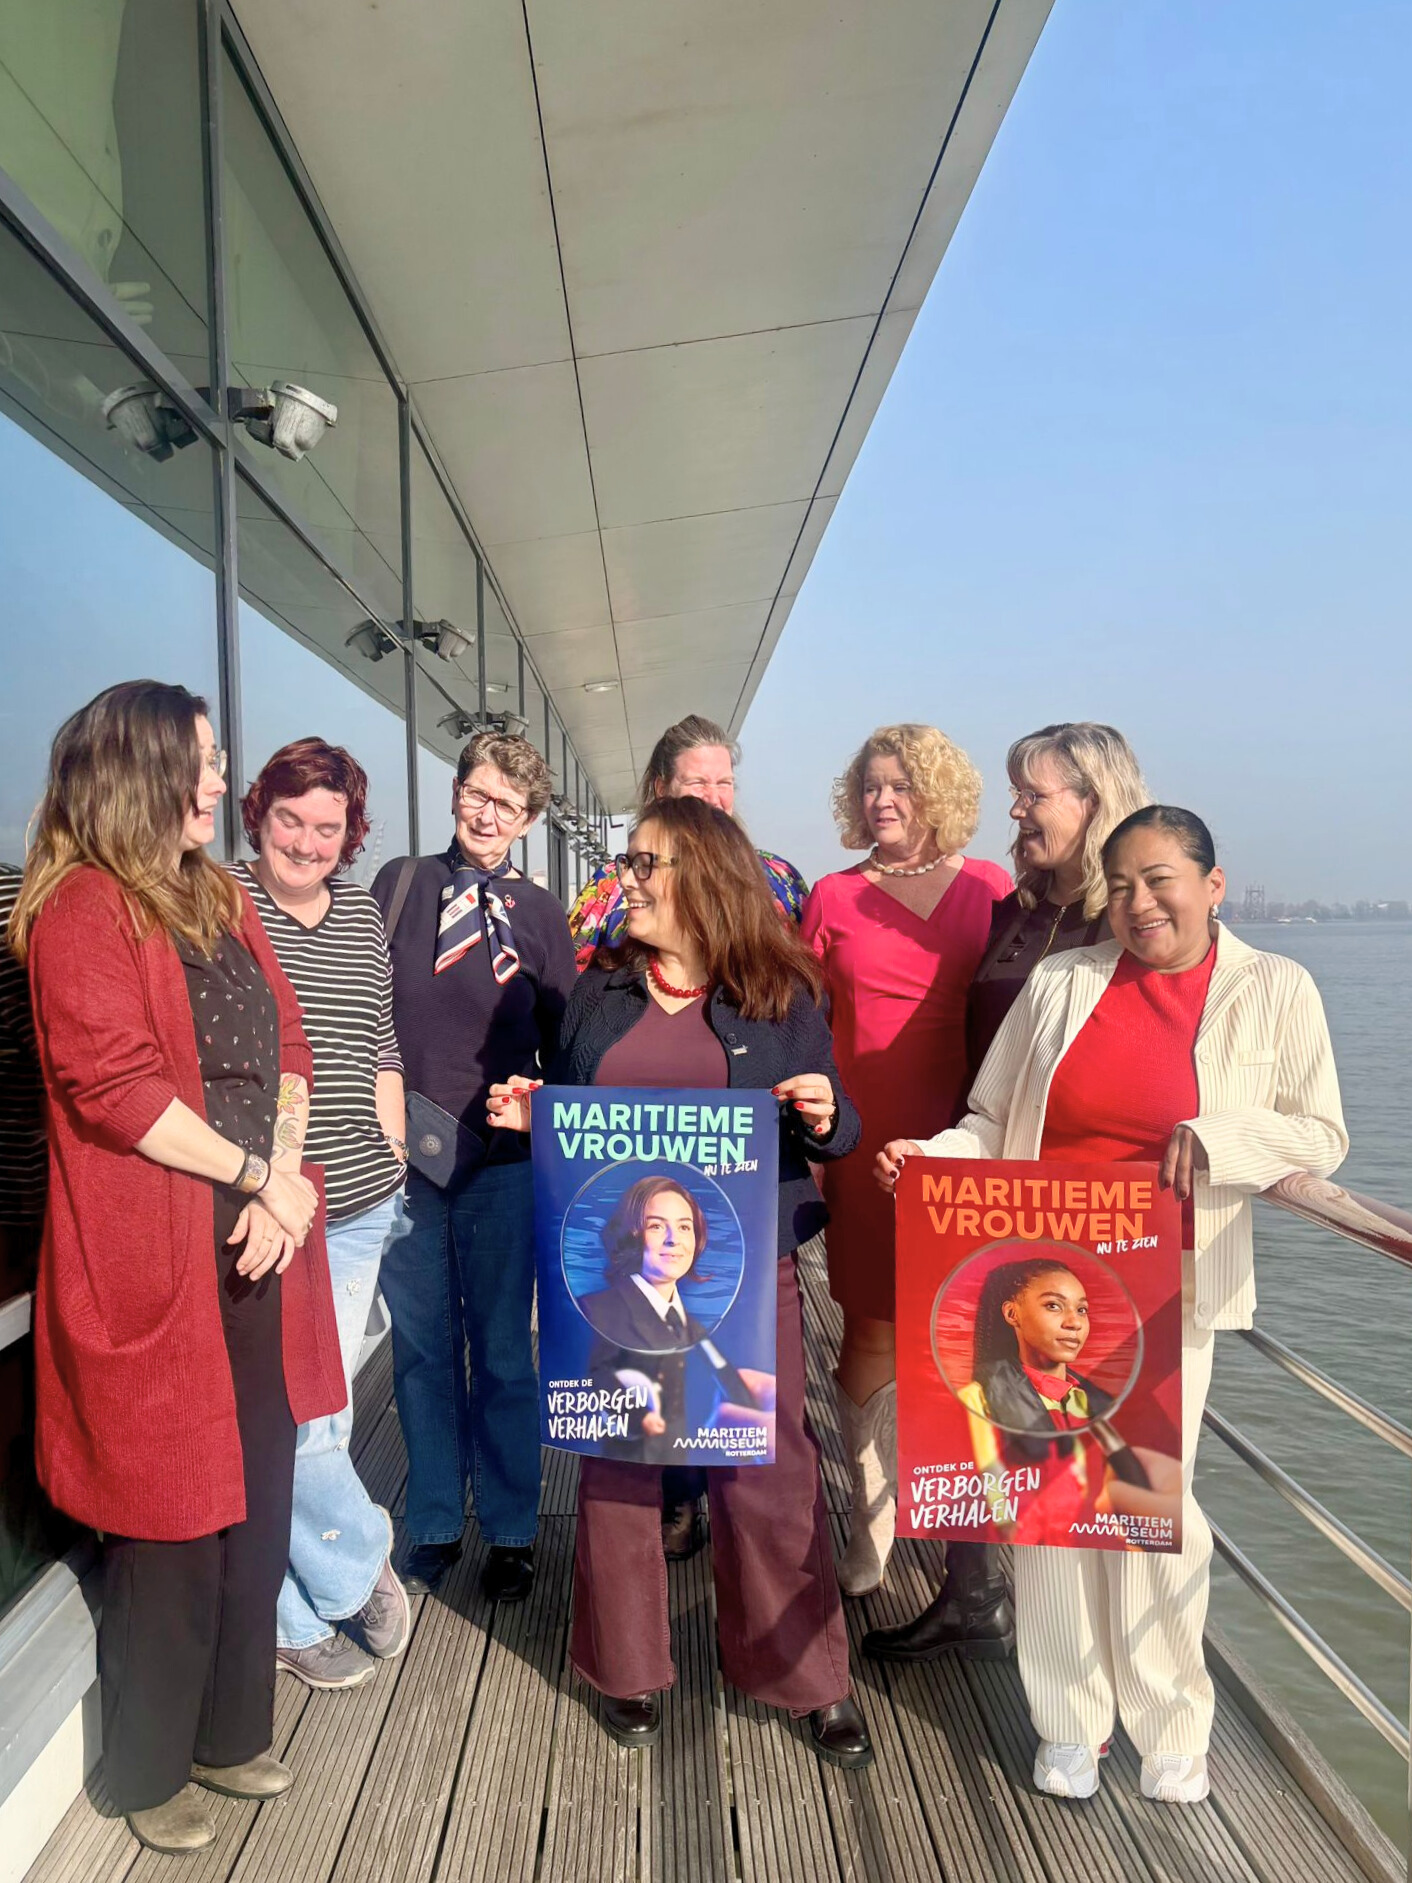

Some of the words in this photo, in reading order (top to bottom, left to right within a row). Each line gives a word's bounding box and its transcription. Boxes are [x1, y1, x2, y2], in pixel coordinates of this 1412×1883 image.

[553, 1102, 754, 1134] MARITIEME
[557, 1132, 746, 1164] VROUWEN
[703, 1164, 718, 1176] NU
[720, 1163, 732, 1174] TE
[734, 1159, 758, 1172] ZIEN
[921, 1174, 1152, 1210] MARITIEME
[927, 1206, 1144, 1241] VROUWEN
[1096, 1241, 1112, 1254] NU
[1115, 1239, 1128, 1253] TE
[1132, 1235, 1158, 1249] ZIEN
[548, 1379, 580, 1388] ONTDEK
[581, 1378, 593, 1387] DE
[547, 1385, 648, 1414] VERBORGEN
[548, 1413, 629, 1442] VERHALEN
[697, 1426, 768, 1438] MARITIEM
[673, 1437, 767, 1449] MUSEUM
[725, 1449, 767, 1457] ROTTERDAM
[913, 1464, 957, 1475] ONTDEK
[959, 1461, 974, 1471] DE
[910, 1466, 1041, 1503] VERBORGEN
[910, 1496, 1019, 1529] VERHALEN
[1095, 1512, 1173, 1529] MARITIEM
[1068, 1522, 1173, 1539] MUSEUM
[1125, 1538, 1173, 1547] ROTTERDAM
